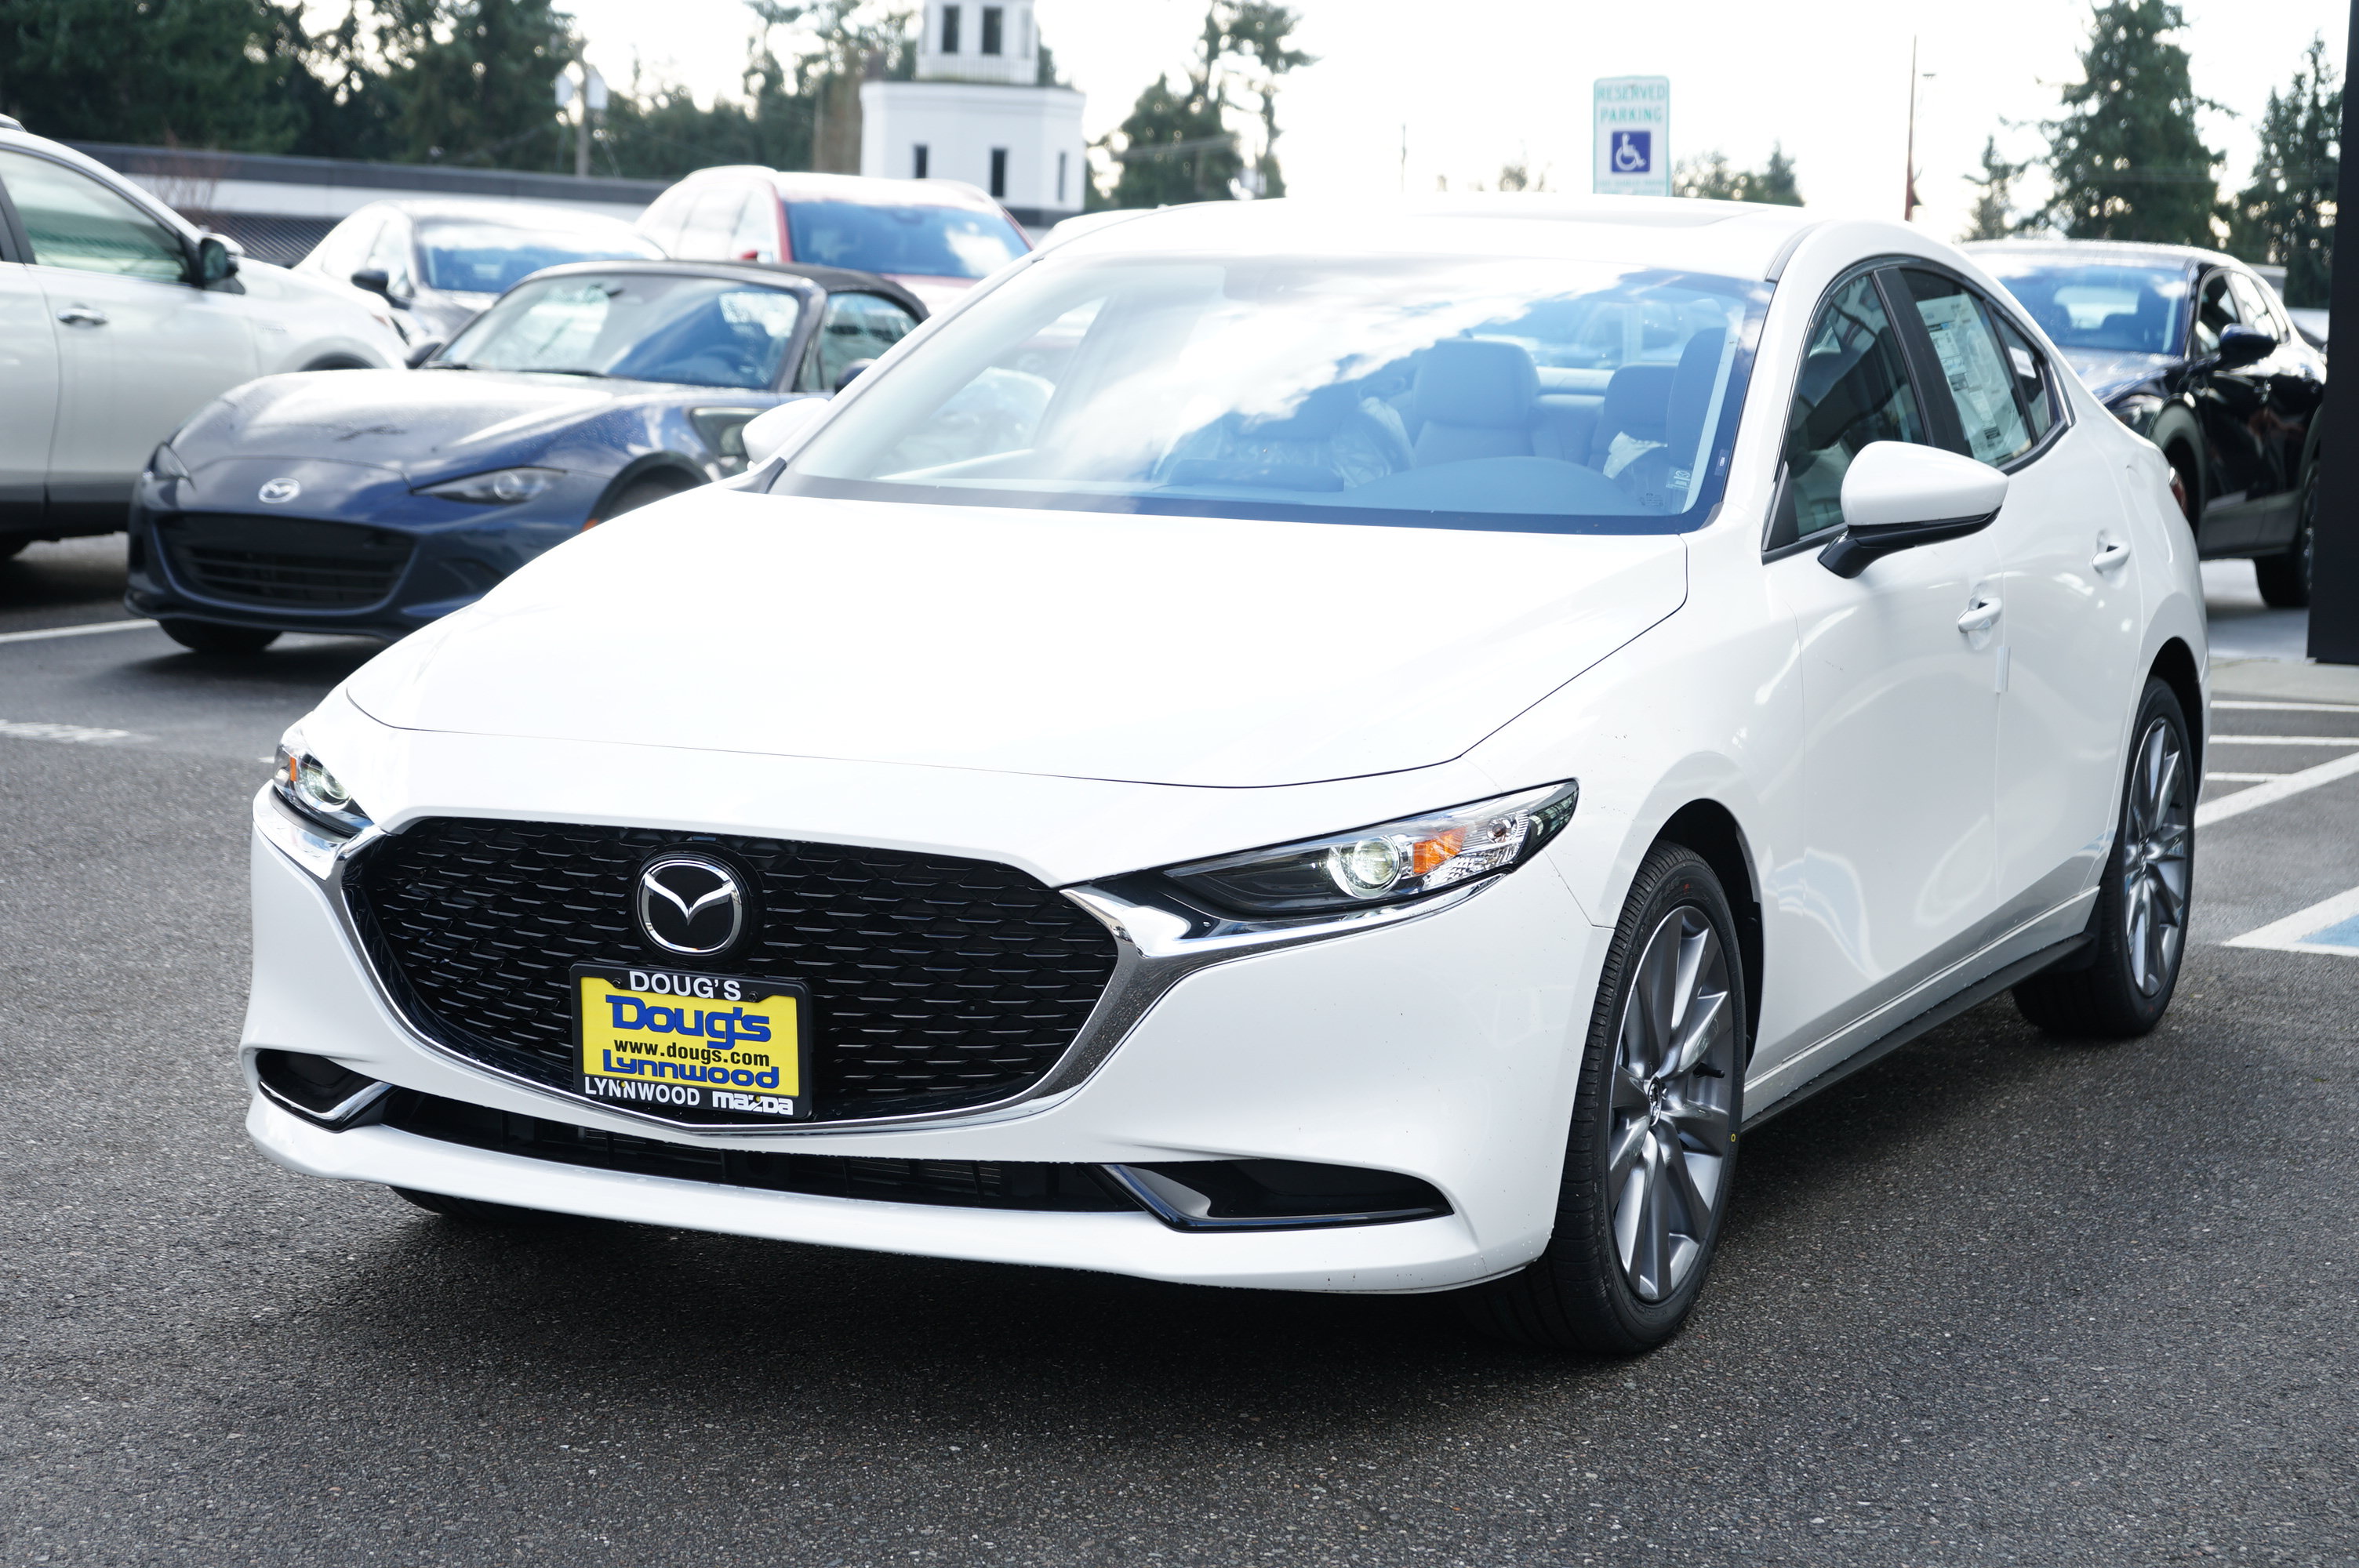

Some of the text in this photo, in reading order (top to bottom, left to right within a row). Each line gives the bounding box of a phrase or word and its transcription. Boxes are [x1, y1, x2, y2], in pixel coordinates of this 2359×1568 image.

[1597, 84, 1665, 100] RESERVED
[1600, 106, 1663, 123] PARKING
[629, 971, 741, 1002] DOUG'S
[605, 994, 772, 1051] Doug's
[614, 1040, 770, 1067] www.dougs.com
[602, 1049, 780, 1089] Lynnwood
[584, 1076, 700, 1106] LYNNWOOD
